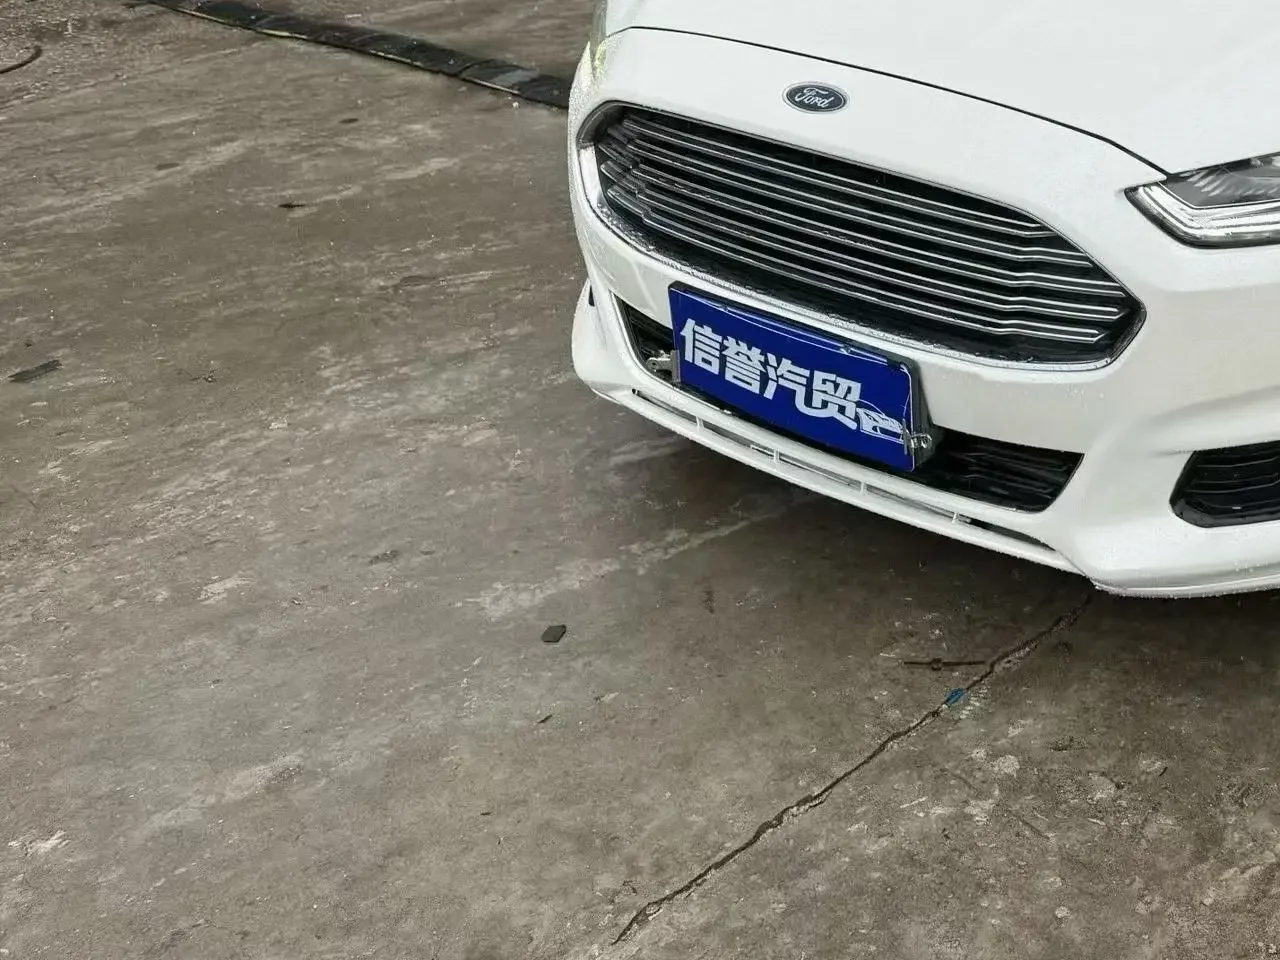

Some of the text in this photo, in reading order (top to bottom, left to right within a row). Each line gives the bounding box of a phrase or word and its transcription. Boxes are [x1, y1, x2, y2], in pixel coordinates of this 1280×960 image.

[794, 87, 835, 108] Ford
[680, 317, 862, 430] 信誉汽贸
